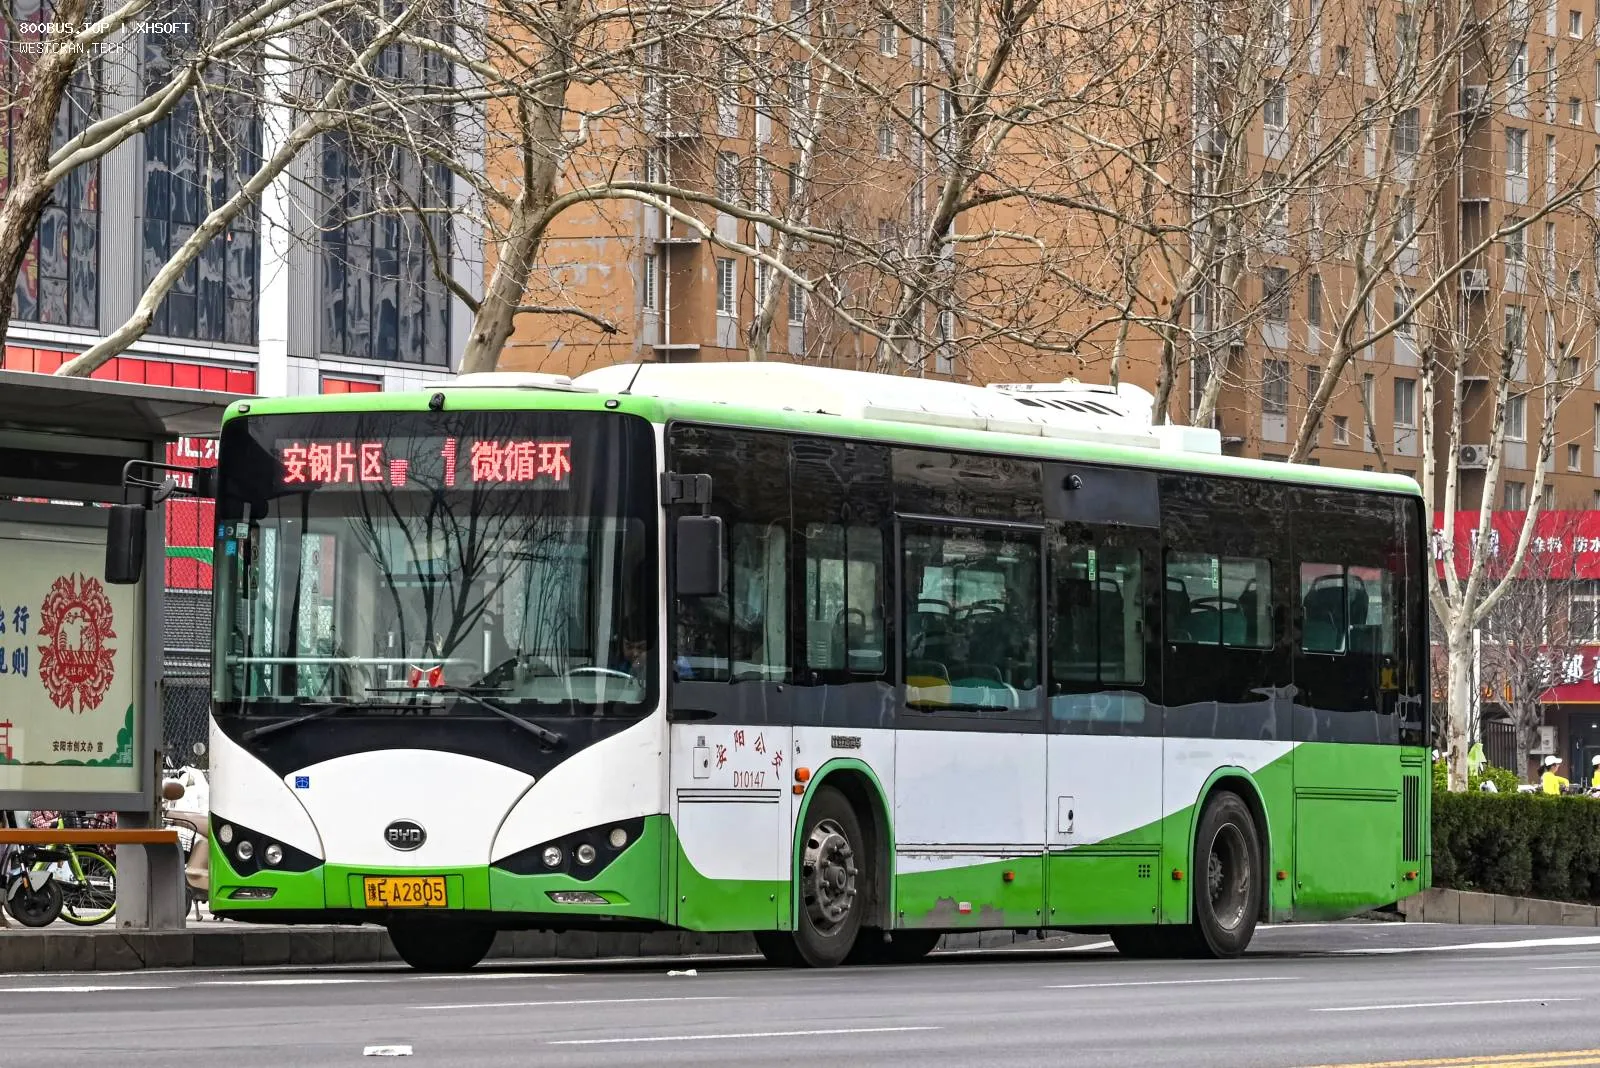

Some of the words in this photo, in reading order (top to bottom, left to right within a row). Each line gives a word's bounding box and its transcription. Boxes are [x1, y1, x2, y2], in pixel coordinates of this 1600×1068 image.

[283, 442, 384, 484] 安钢片区
[470, 440, 572, 483] 微循环
[733, 770, 766, 788] D10147
[388, 828, 421, 841] BYD
